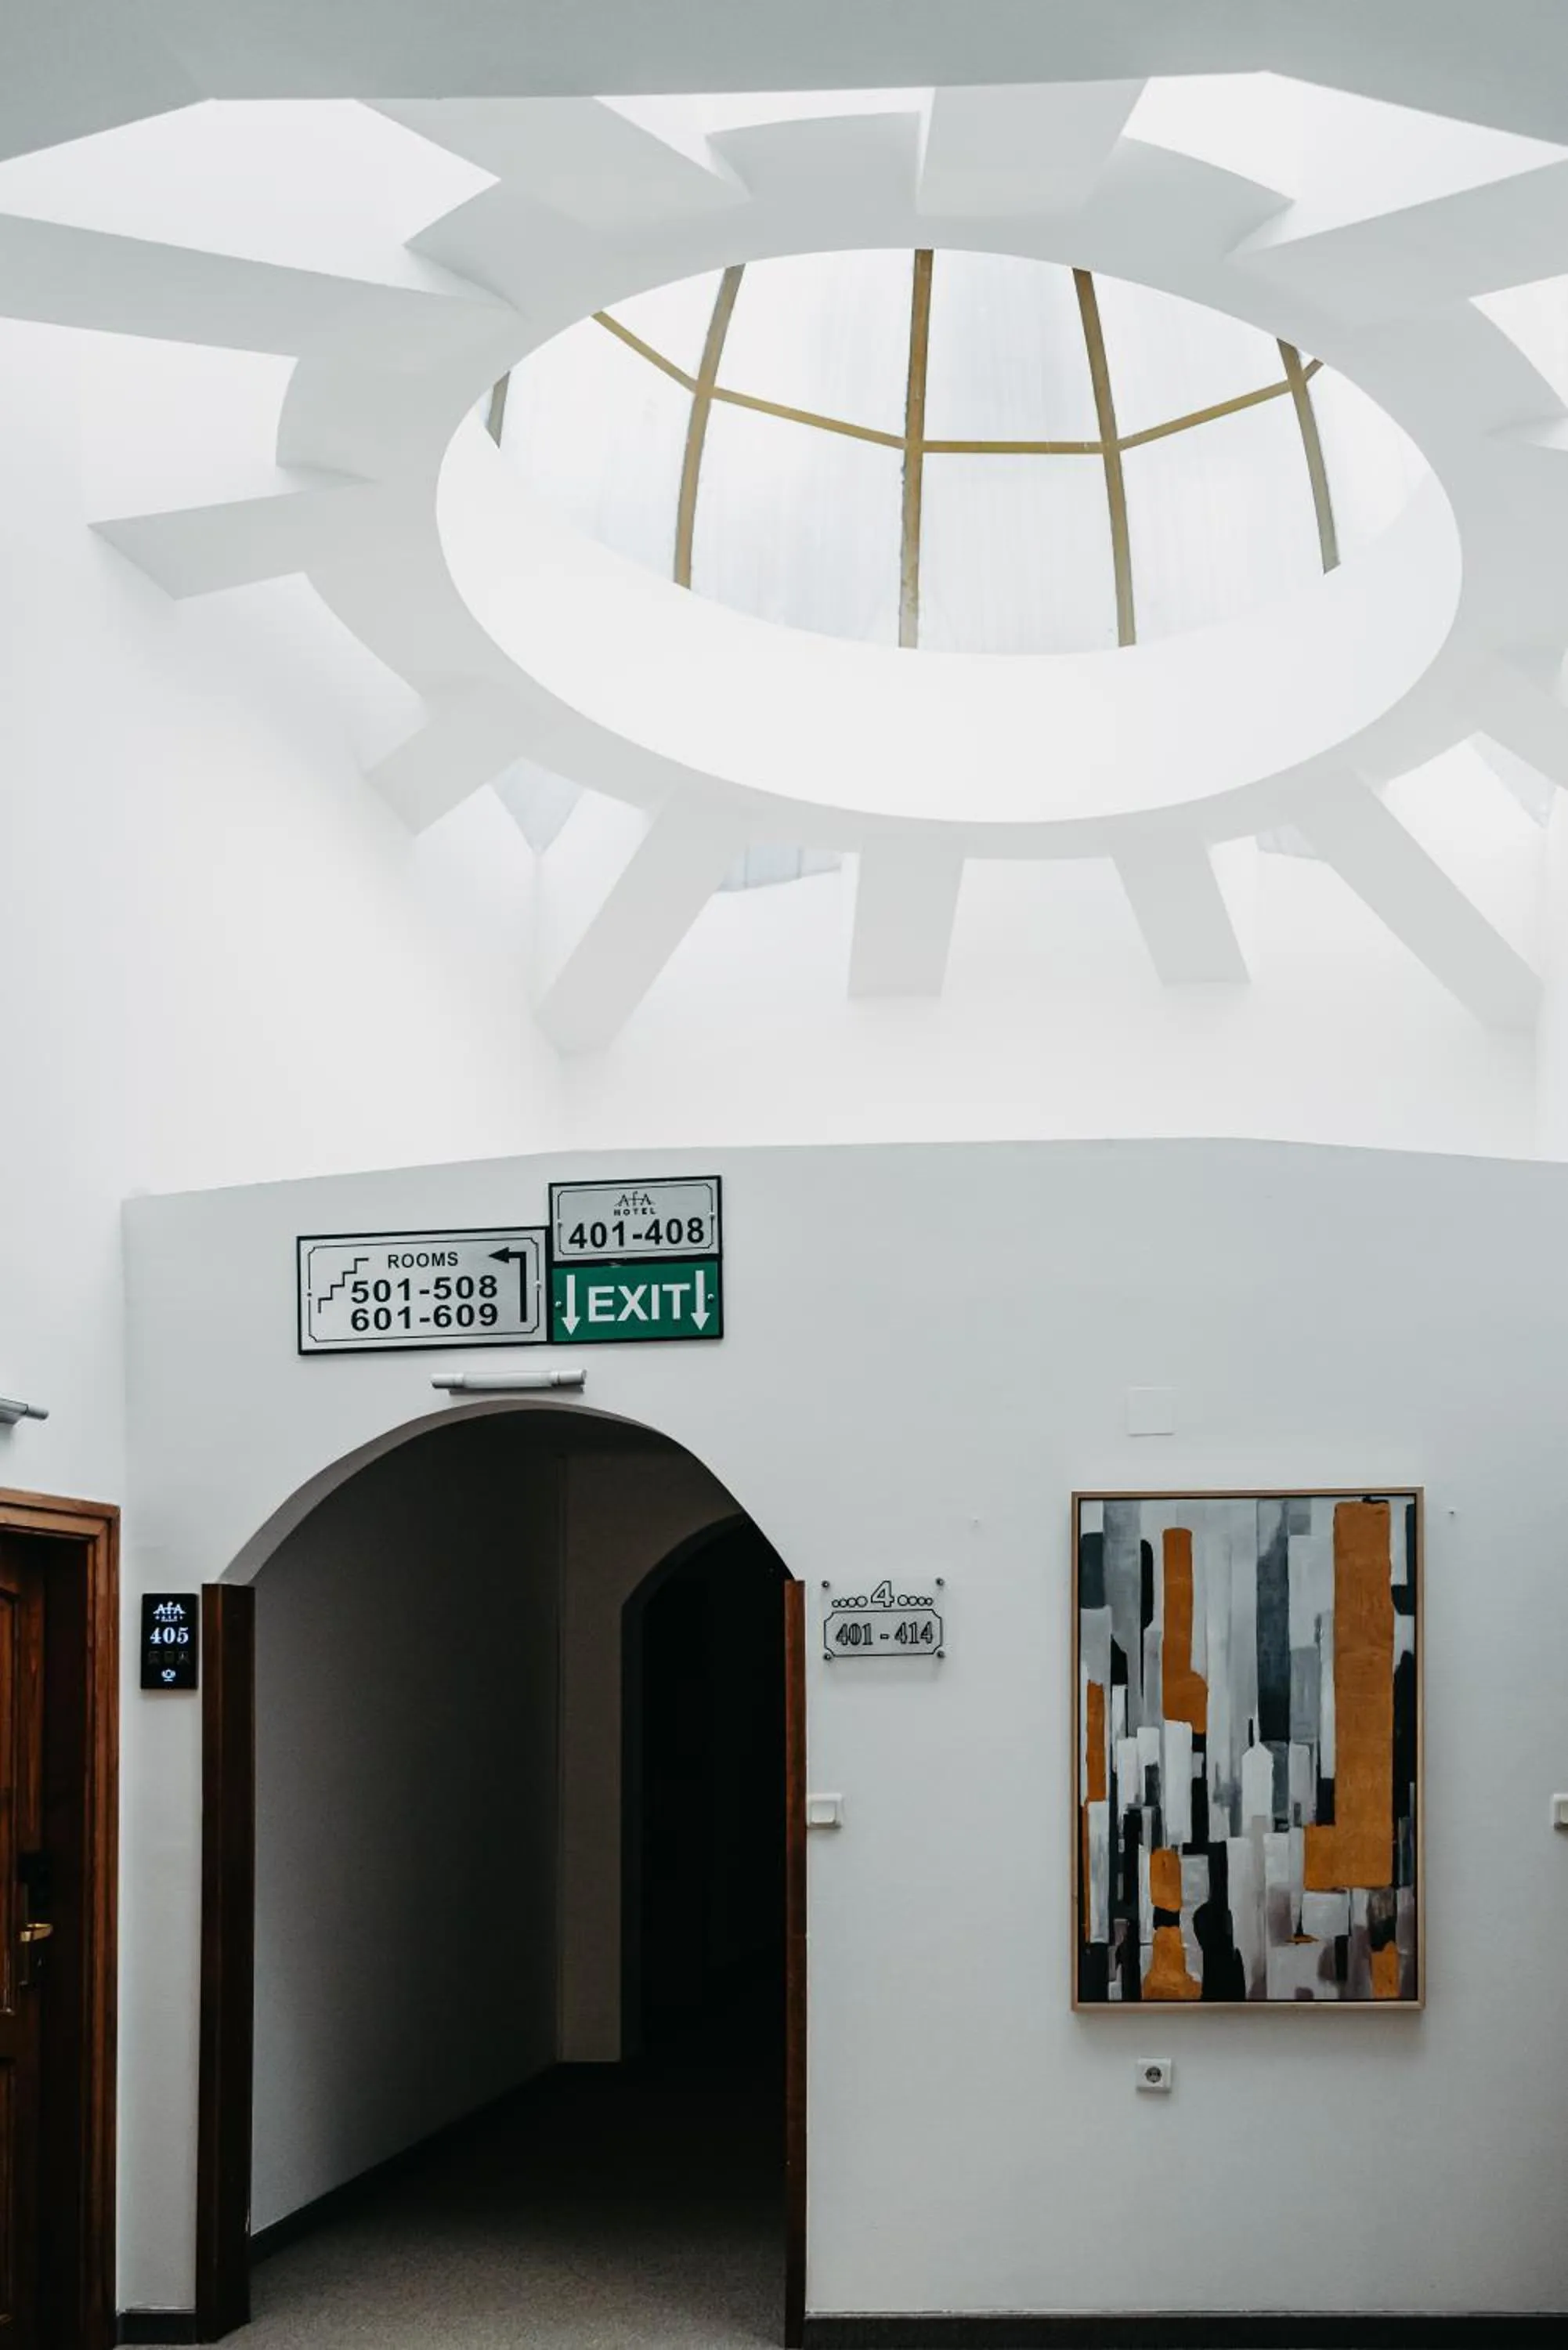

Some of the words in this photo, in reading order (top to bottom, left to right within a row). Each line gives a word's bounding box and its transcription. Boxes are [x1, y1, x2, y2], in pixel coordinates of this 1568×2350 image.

[614, 1206, 656, 1217] HOTEL
[568, 1217, 705, 1249] 401-408
[388, 1251, 459, 1269] ROOMS
[350, 1274, 498, 1304] 501-508
[587, 1282, 692, 1323] EXIT
[350, 1303, 498, 1332] 601-609
[871, 1580, 894, 1607] 4
[150, 1627, 189, 1644] 405
[836, 1623, 873, 1646] 401
[894, 1622, 934, 1644] 414
